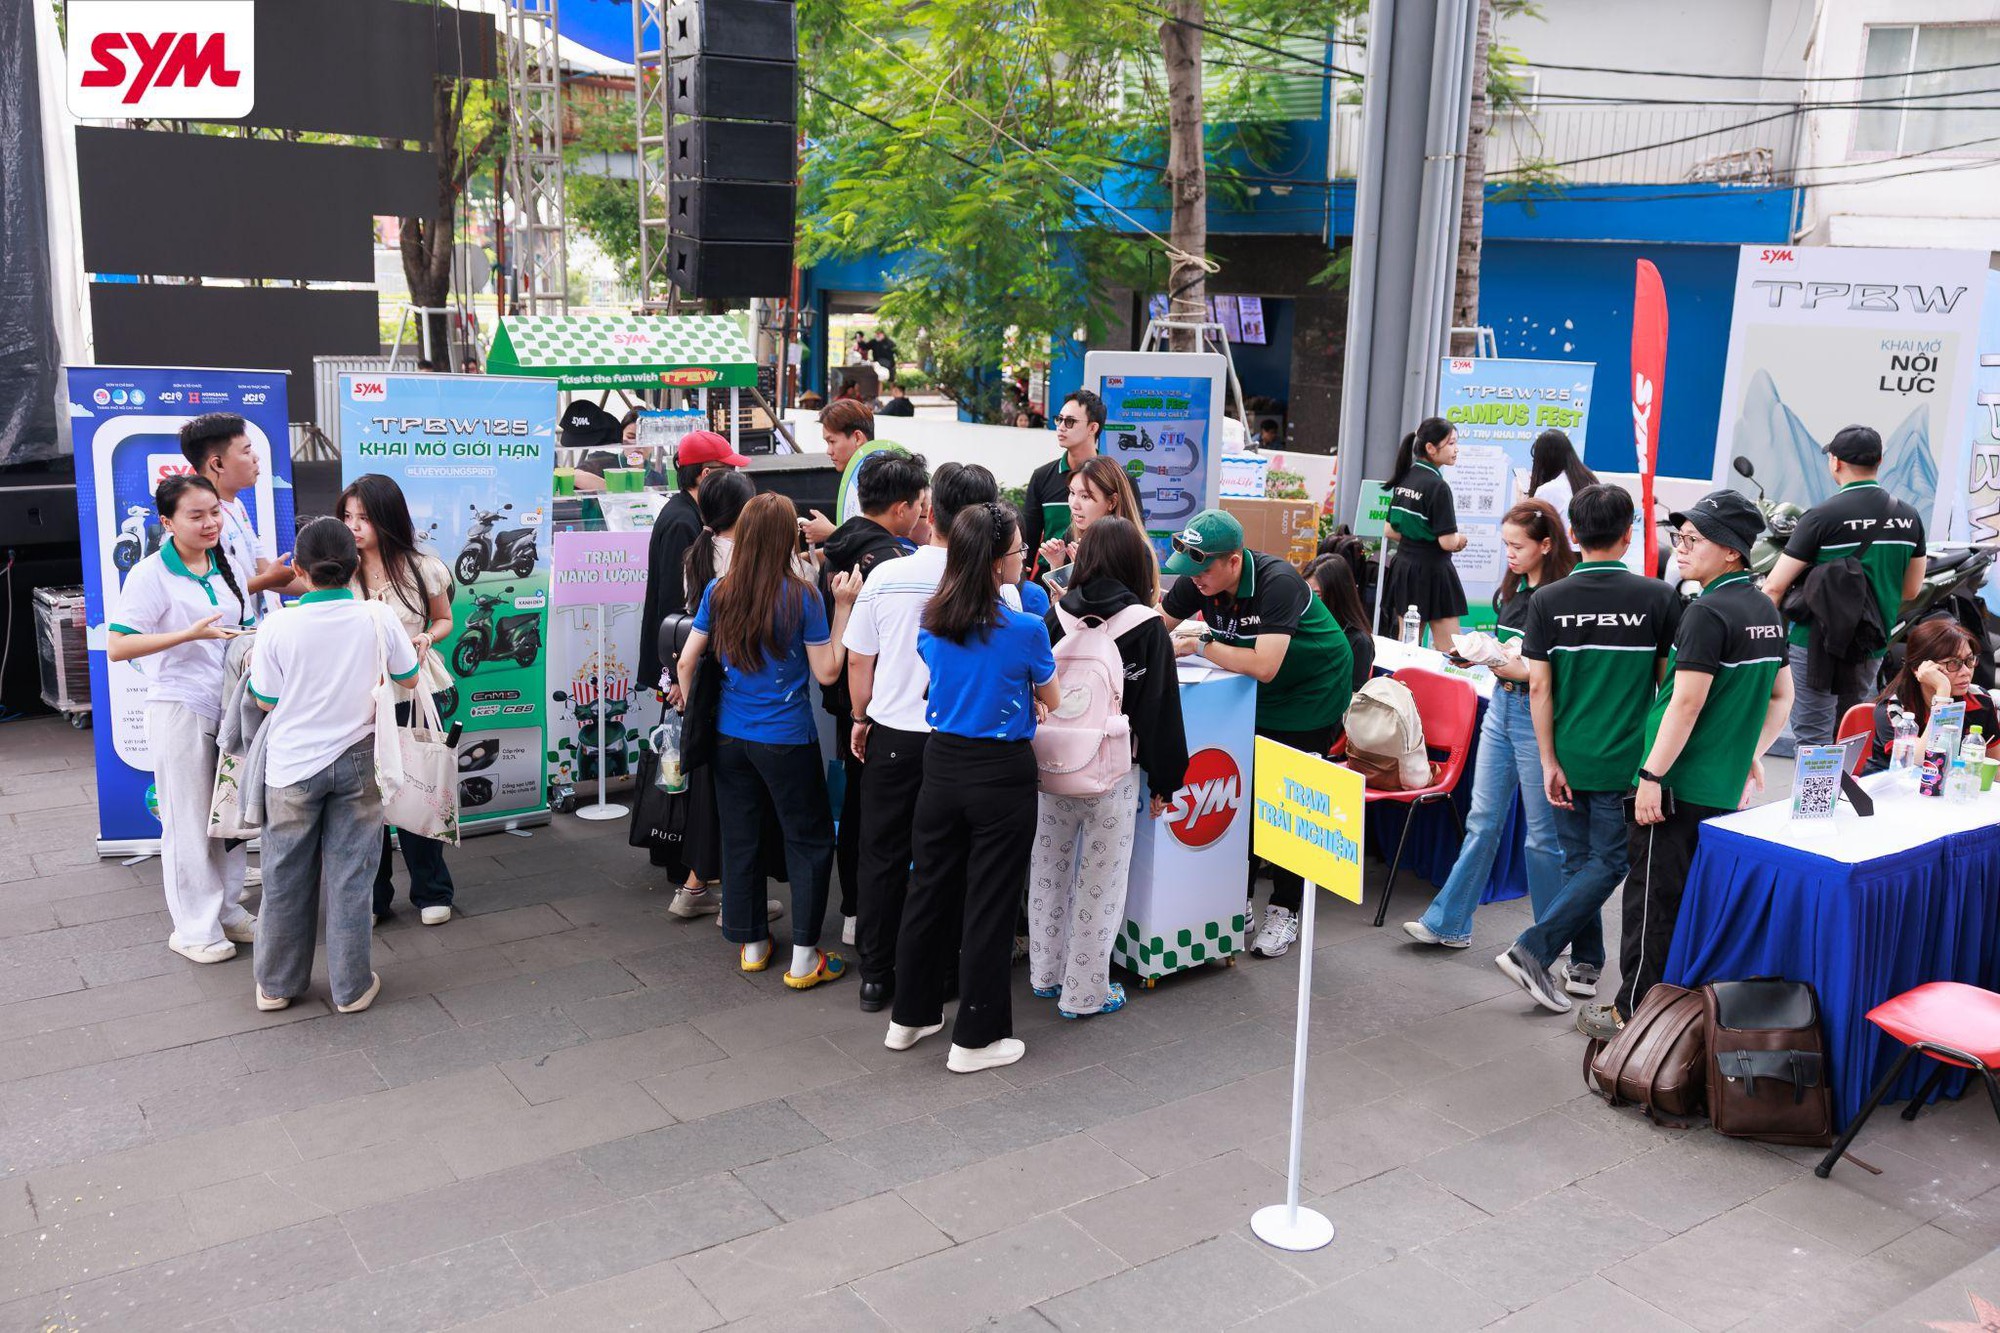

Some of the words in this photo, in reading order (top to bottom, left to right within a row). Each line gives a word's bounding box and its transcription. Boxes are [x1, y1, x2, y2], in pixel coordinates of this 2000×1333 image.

[1761, 250, 1794, 264] SYM
[1752, 280, 1968, 313] TPBW
[614, 334, 650, 346] SYM
[1881, 340, 1913, 351] KHAI
[1917, 340, 1942, 353] MỞ
[1452, 361, 1472, 371] SYM
[1891, 353, 1938, 375] NỘI
[593, 373, 612, 384] the
[613, 373, 632, 383] fun
[633, 372, 658, 382] with
[1879, 376, 1935, 396] LỰC
[354, 383, 384, 396] SYM
[572, 416, 590, 427] SYM
[1447, 402, 1530, 427] CAMPUS
[1536, 405, 1584, 428] FEST
[360, 442, 408, 456] KHAI
[415, 440, 447, 456] MỞ
[453, 440, 491, 457] GIỚI
[498, 444, 540, 460] HẠN
[584, 550, 627, 567] TRẠM
[1240, 615, 1262, 626] SYM
[1554, 613, 1647, 628] TPBW
[1745, 624, 1784, 640] TPB
[1164, 774, 1241, 831] SYM
[1283, 776, 1331, 817] TRẠM
[1256, 798, 1292, 834] TRẢI
[1295, 814, 1359, 866] NGHIỆM
